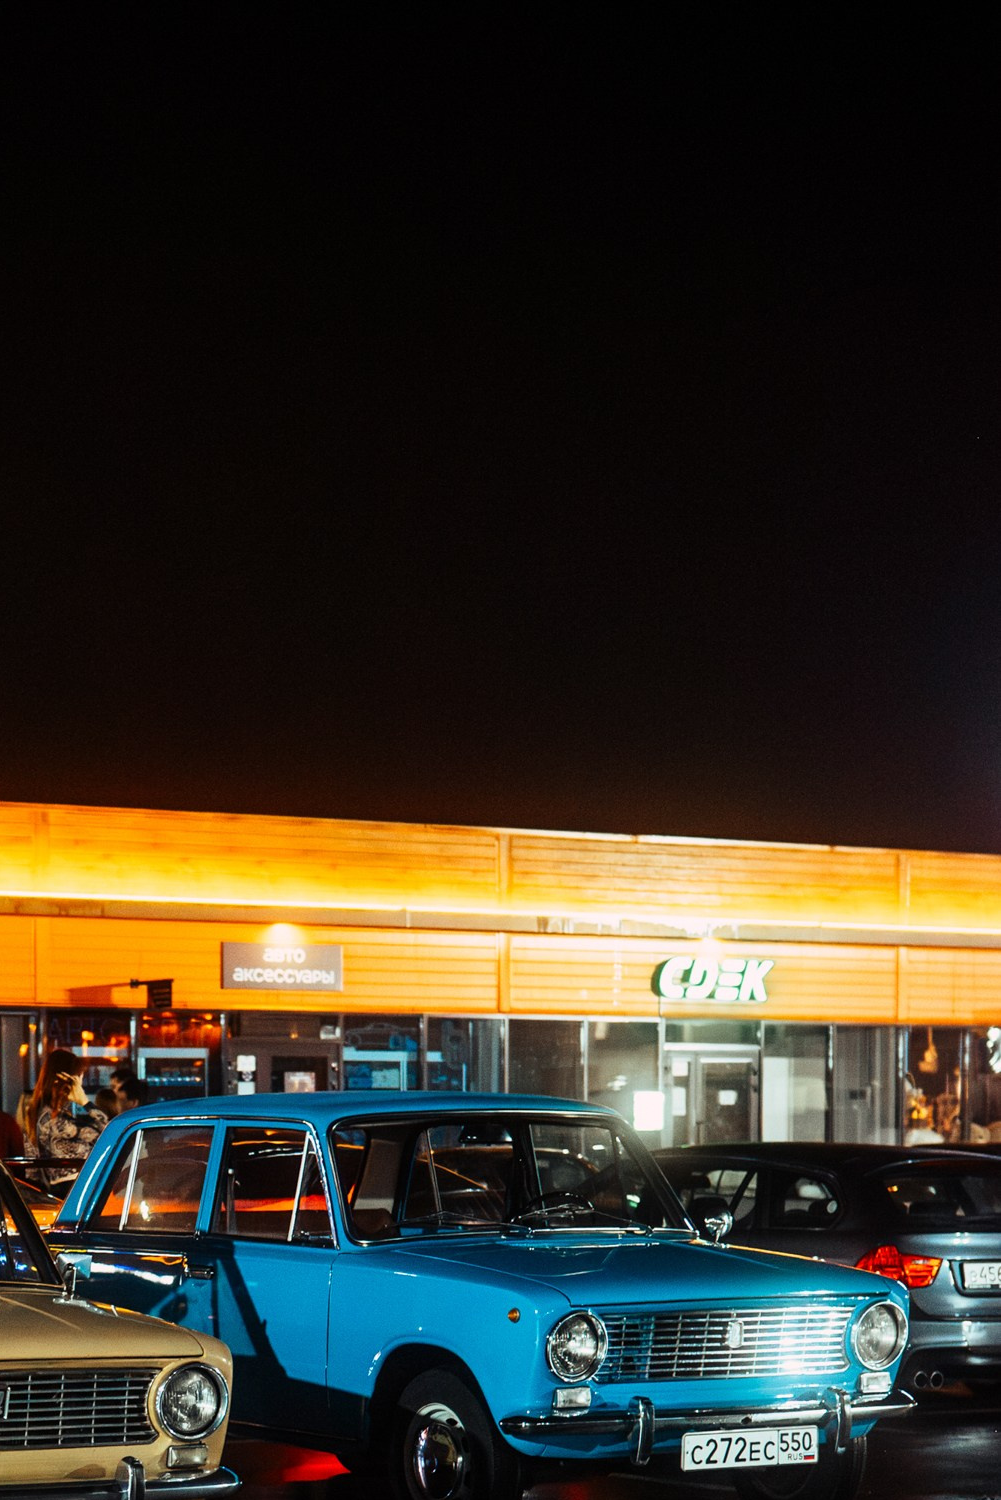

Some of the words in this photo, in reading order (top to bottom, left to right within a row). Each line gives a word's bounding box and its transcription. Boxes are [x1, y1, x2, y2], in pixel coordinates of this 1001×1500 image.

[262, 947, 307, 964] авто
[232, 966, 336, 985] аксессуары
[690, 1437, 775, 1465] С272ЕС
[780, 1431, 813, 1451] 550
[787, 1453, 804, 1461] RUS
